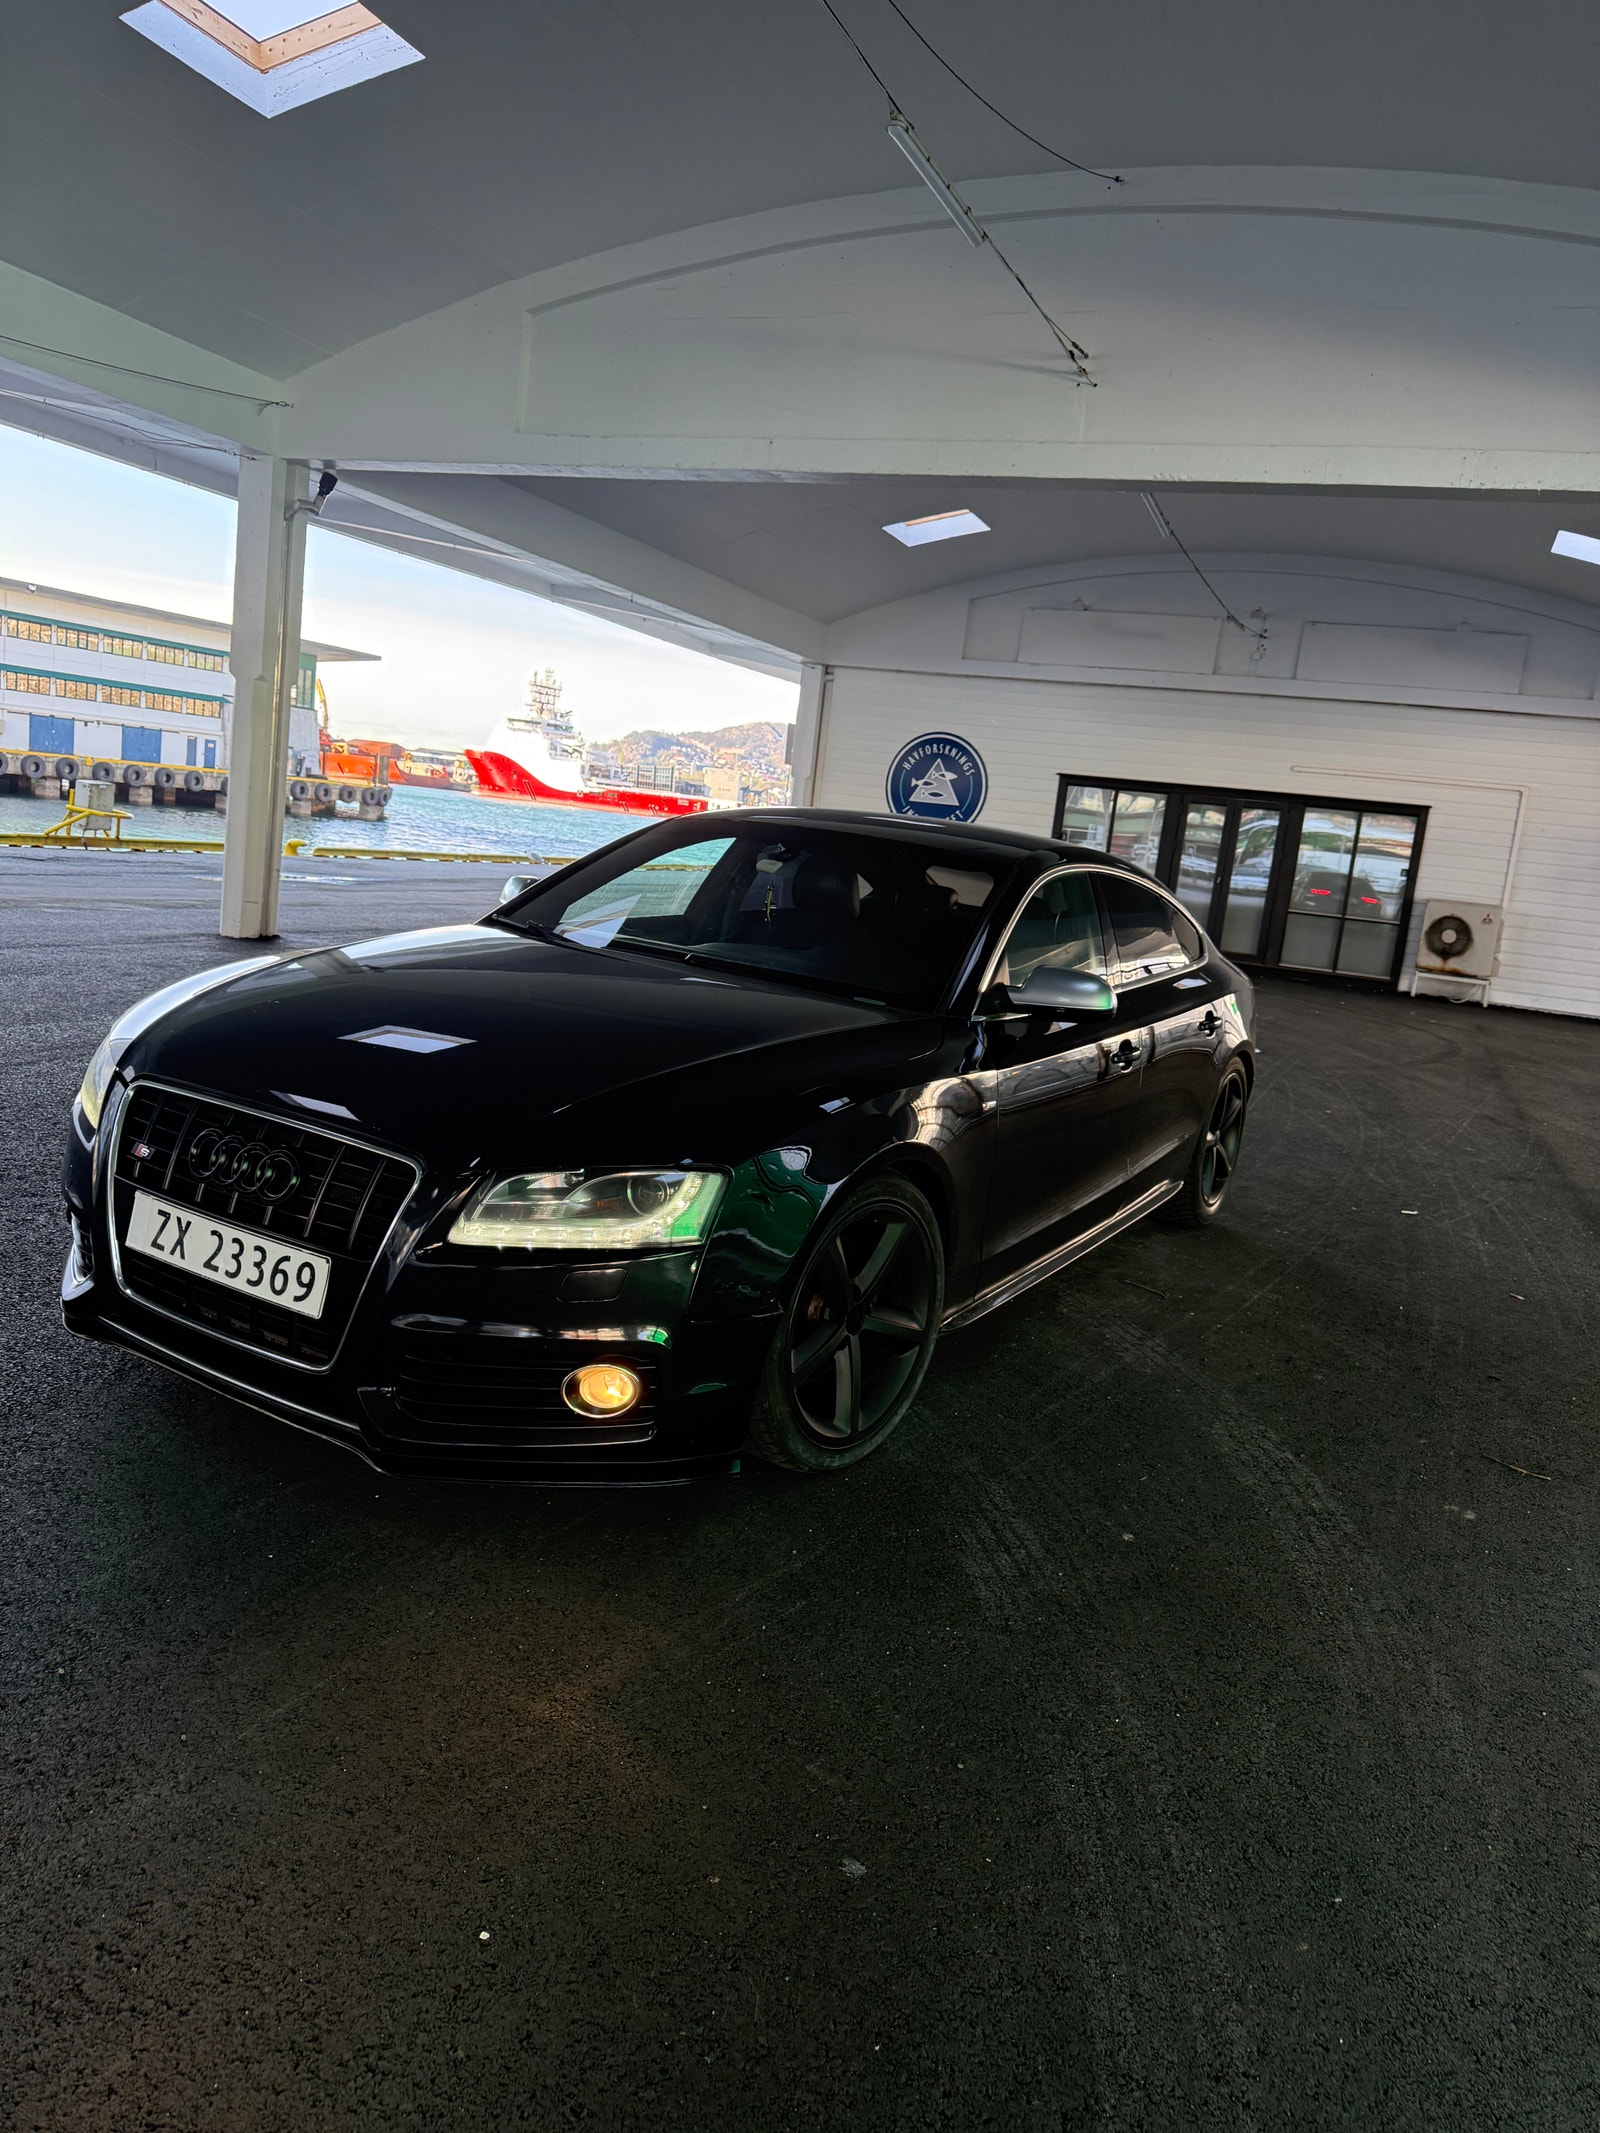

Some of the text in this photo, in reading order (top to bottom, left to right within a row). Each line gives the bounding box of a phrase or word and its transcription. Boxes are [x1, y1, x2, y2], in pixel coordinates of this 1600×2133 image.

[902, 743, 976, 776] HAVFORSKNINGS
[150, 1209, 316, 1302] ZX 23369
